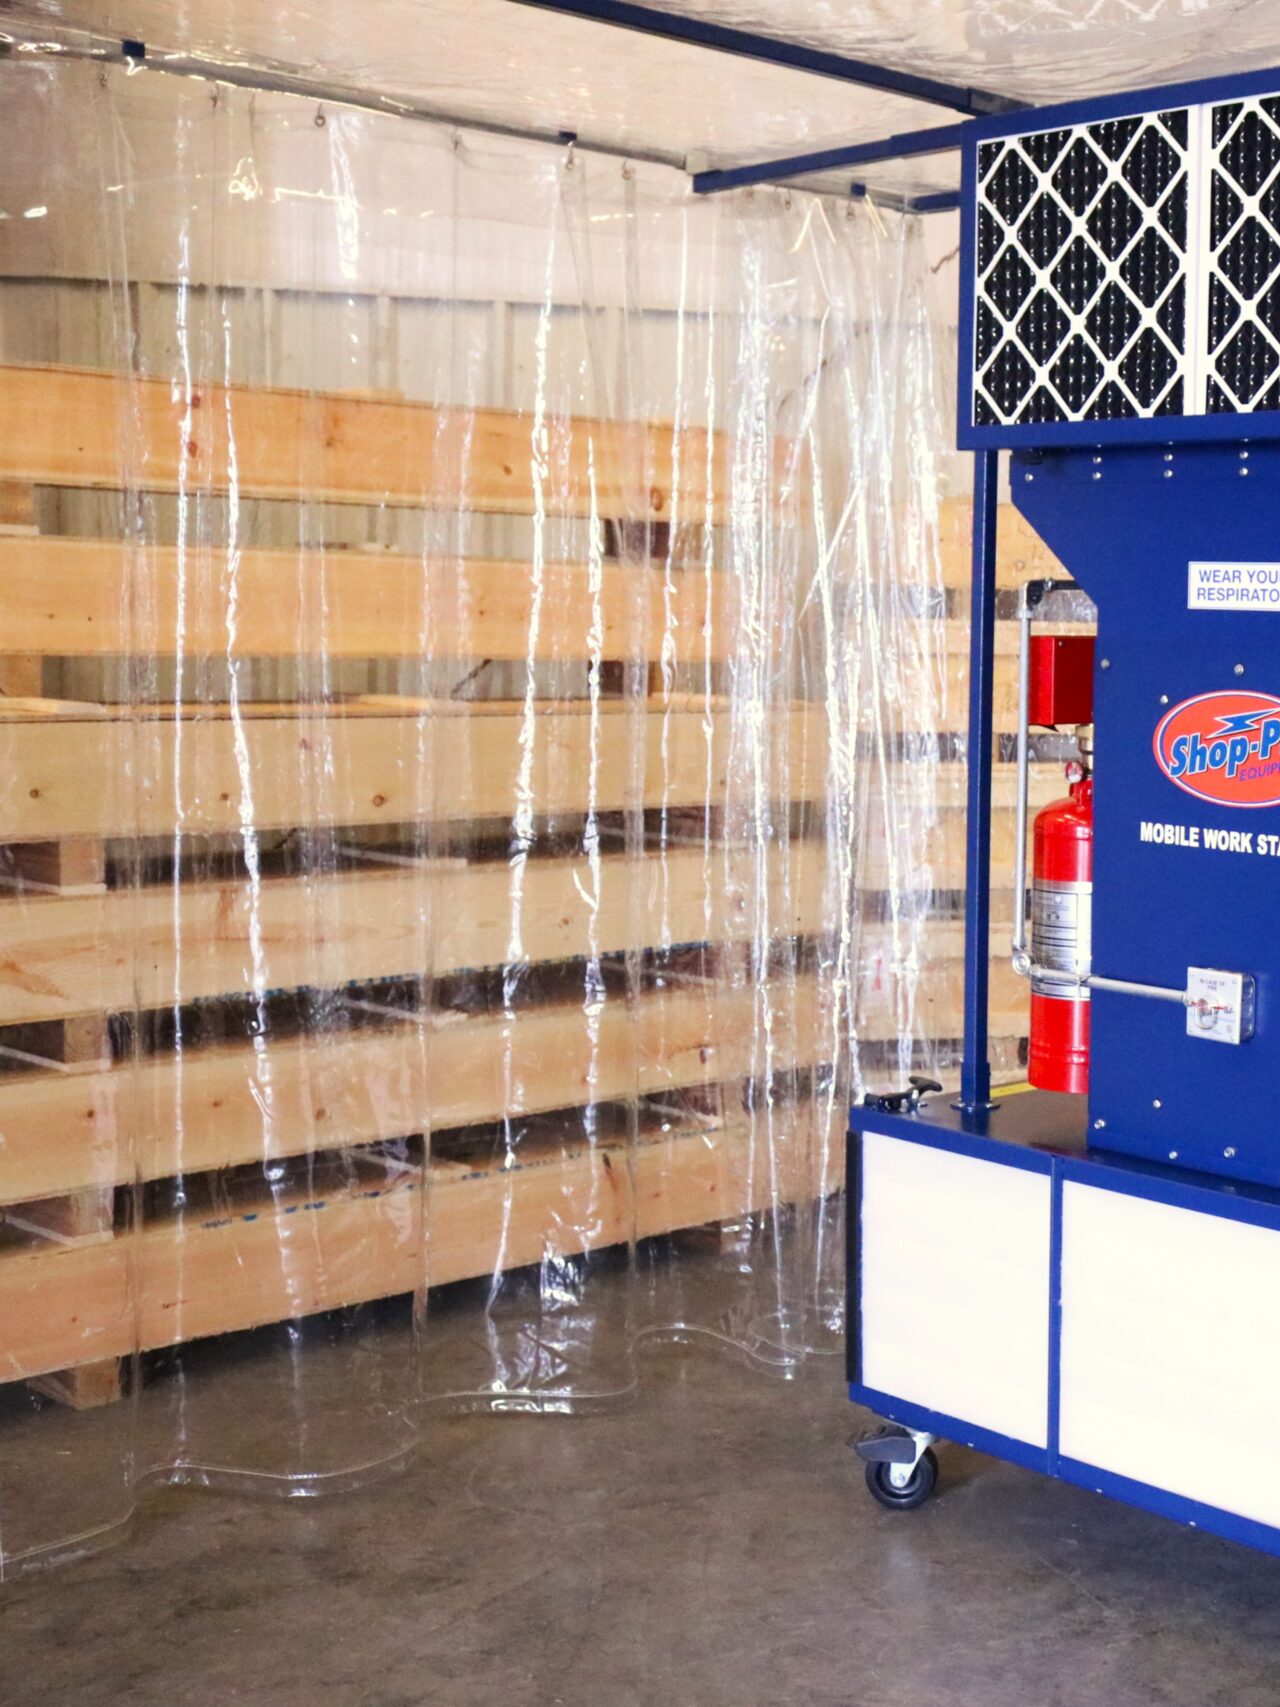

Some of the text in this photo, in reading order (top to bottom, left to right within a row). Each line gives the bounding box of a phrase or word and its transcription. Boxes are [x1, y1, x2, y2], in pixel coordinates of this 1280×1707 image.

[1198, 569, 1242, 583] WEAR
[1140, 821, 1200, 848] MOBILE
[1203, 828, 1253, 854] WORK
